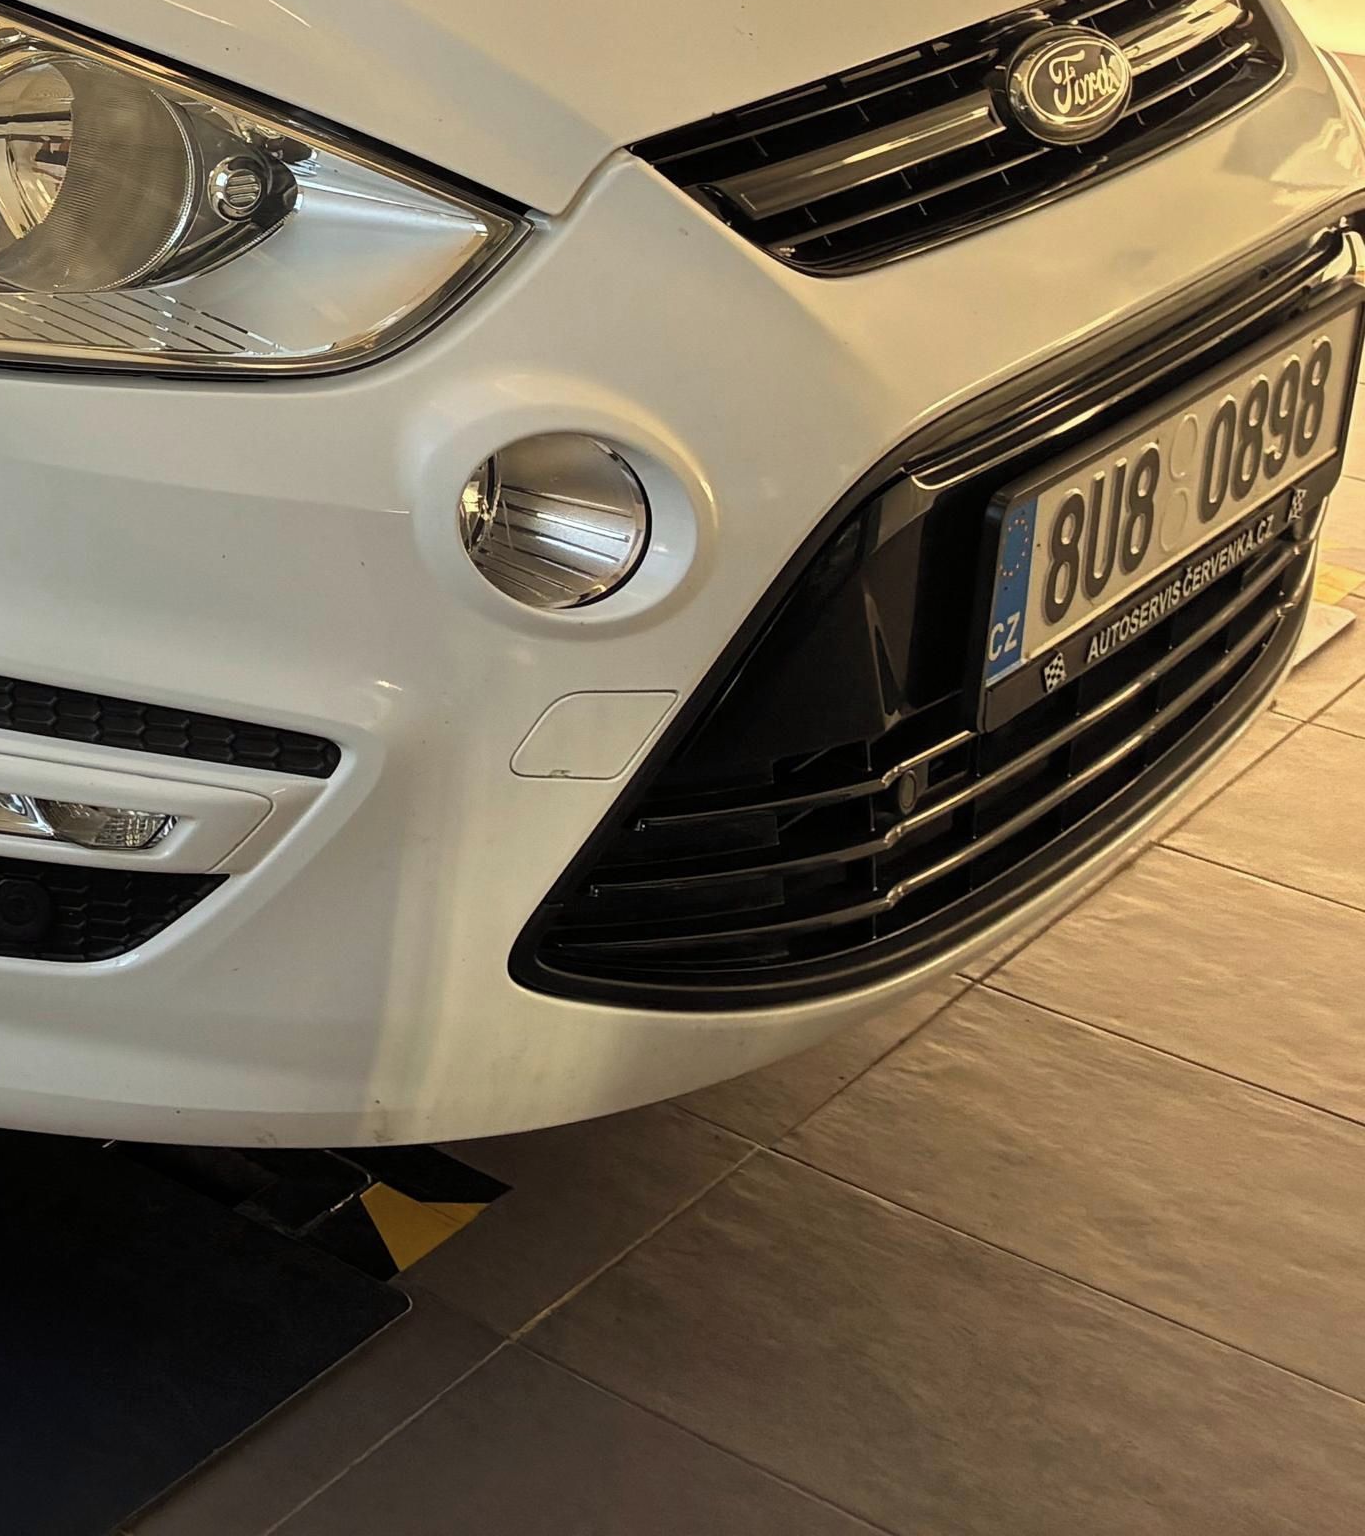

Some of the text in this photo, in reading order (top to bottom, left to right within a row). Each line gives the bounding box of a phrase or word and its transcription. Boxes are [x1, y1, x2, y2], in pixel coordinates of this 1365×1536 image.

[1048, 49, 1119, 114] Ford
[1044, 334, 1333, 626] 8U8 0898
[987, 611, 1021, 662] CZ
[1086, 515, 1275, 663] AUTOSERVIS ČERVENKA.CZ
